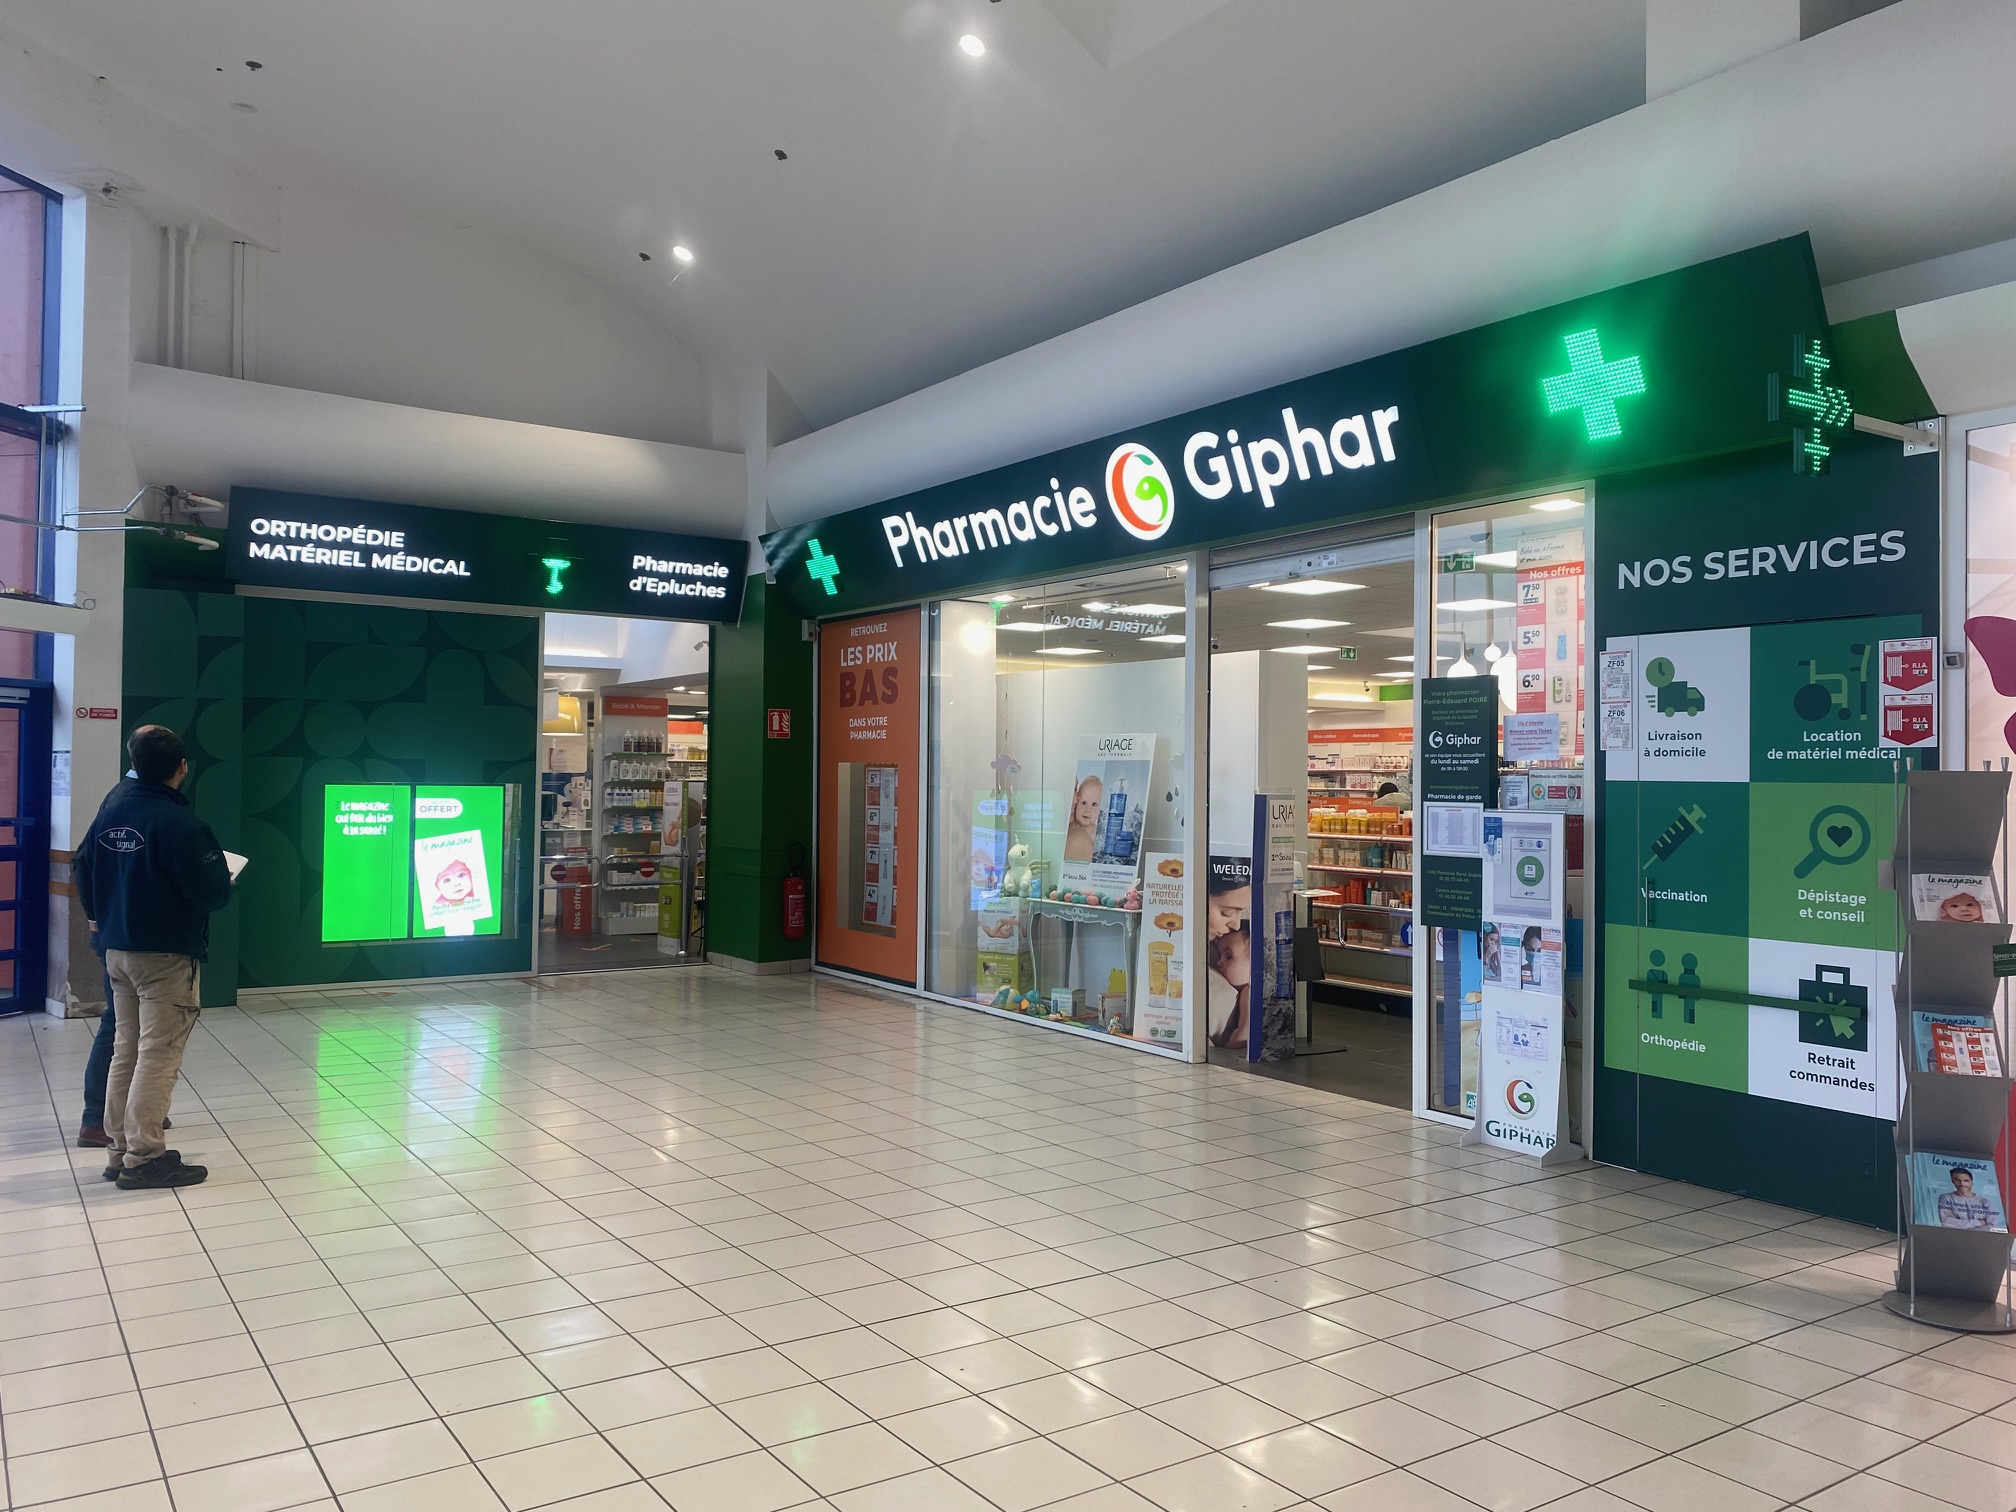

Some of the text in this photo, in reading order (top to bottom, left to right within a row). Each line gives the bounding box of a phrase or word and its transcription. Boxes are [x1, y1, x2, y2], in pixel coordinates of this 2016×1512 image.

[881, 405, 1399, 568] Pharmacie Giphar
[249, 517, 405, 549] ORTHOPÉDIE
[248, 541, 471, 577] MATÉRIEL MÉDICAL
[631, 555, 729, 578] Pharmacie
[1617, 529, 1907, 590] NOS SERVICES
[1529, 566, 1582, 580] Nos offres
[628, 576, 726, 600] d'Epluches
[1522, 583, 1540, 598] 7.50
[850, 623, 888, 637] RETROUVEZ
[1522, 630, 1541, 645] 5.50
[840, 641, 898, 667] LES PRIX
[1607, 660, 1625, 668] ZF05
[839, 666, 899, 708] BAS
[1522, 674, 1541, 688] 6.90
[1607, 710, 1625, 718] ZF06
[849, 717, 888, 728] DANS VOTRE
[850, 730, 887, 740] PHARMACIE
[1446, 733, 1482, 748] Giphar
[1647, 731, 1703, 742] Livraison
[1802, 730, 1862, 743] Location
[1098, 738, 1133, 752] URIAGE
[1644, 745, 1707, 759] à domicile
[1767, 747, 1901, 760] de matériel médical
[1272, 804, 1296, 823] URIA
[116, 840, 136, 851] signal
[1927, 874, 1983, 889] le magazine
[1151, 890, 1180, 899] PROTÉGÉ
[1640, 887, 1708, 903] Vaccination
[1797, 889, 1868, 906] Dépistage
[573, 912, 581, 930] Nos
[1799, 907, 1866, 923] et conseil
[1921, 1012, 1977, 1027] le magazine
[1641, 1032, 1706, 1053] Orthopédie
[1807, 1052, 1857, 1071] Retrait
[1789, 1068, 1875, 1092] commandes
[1485, 1119, 1556, 1149] GIPHAR
[1932, 1155, 1988, 1172] le magazine
[1972, 1209, 2001, 1217] cancer
